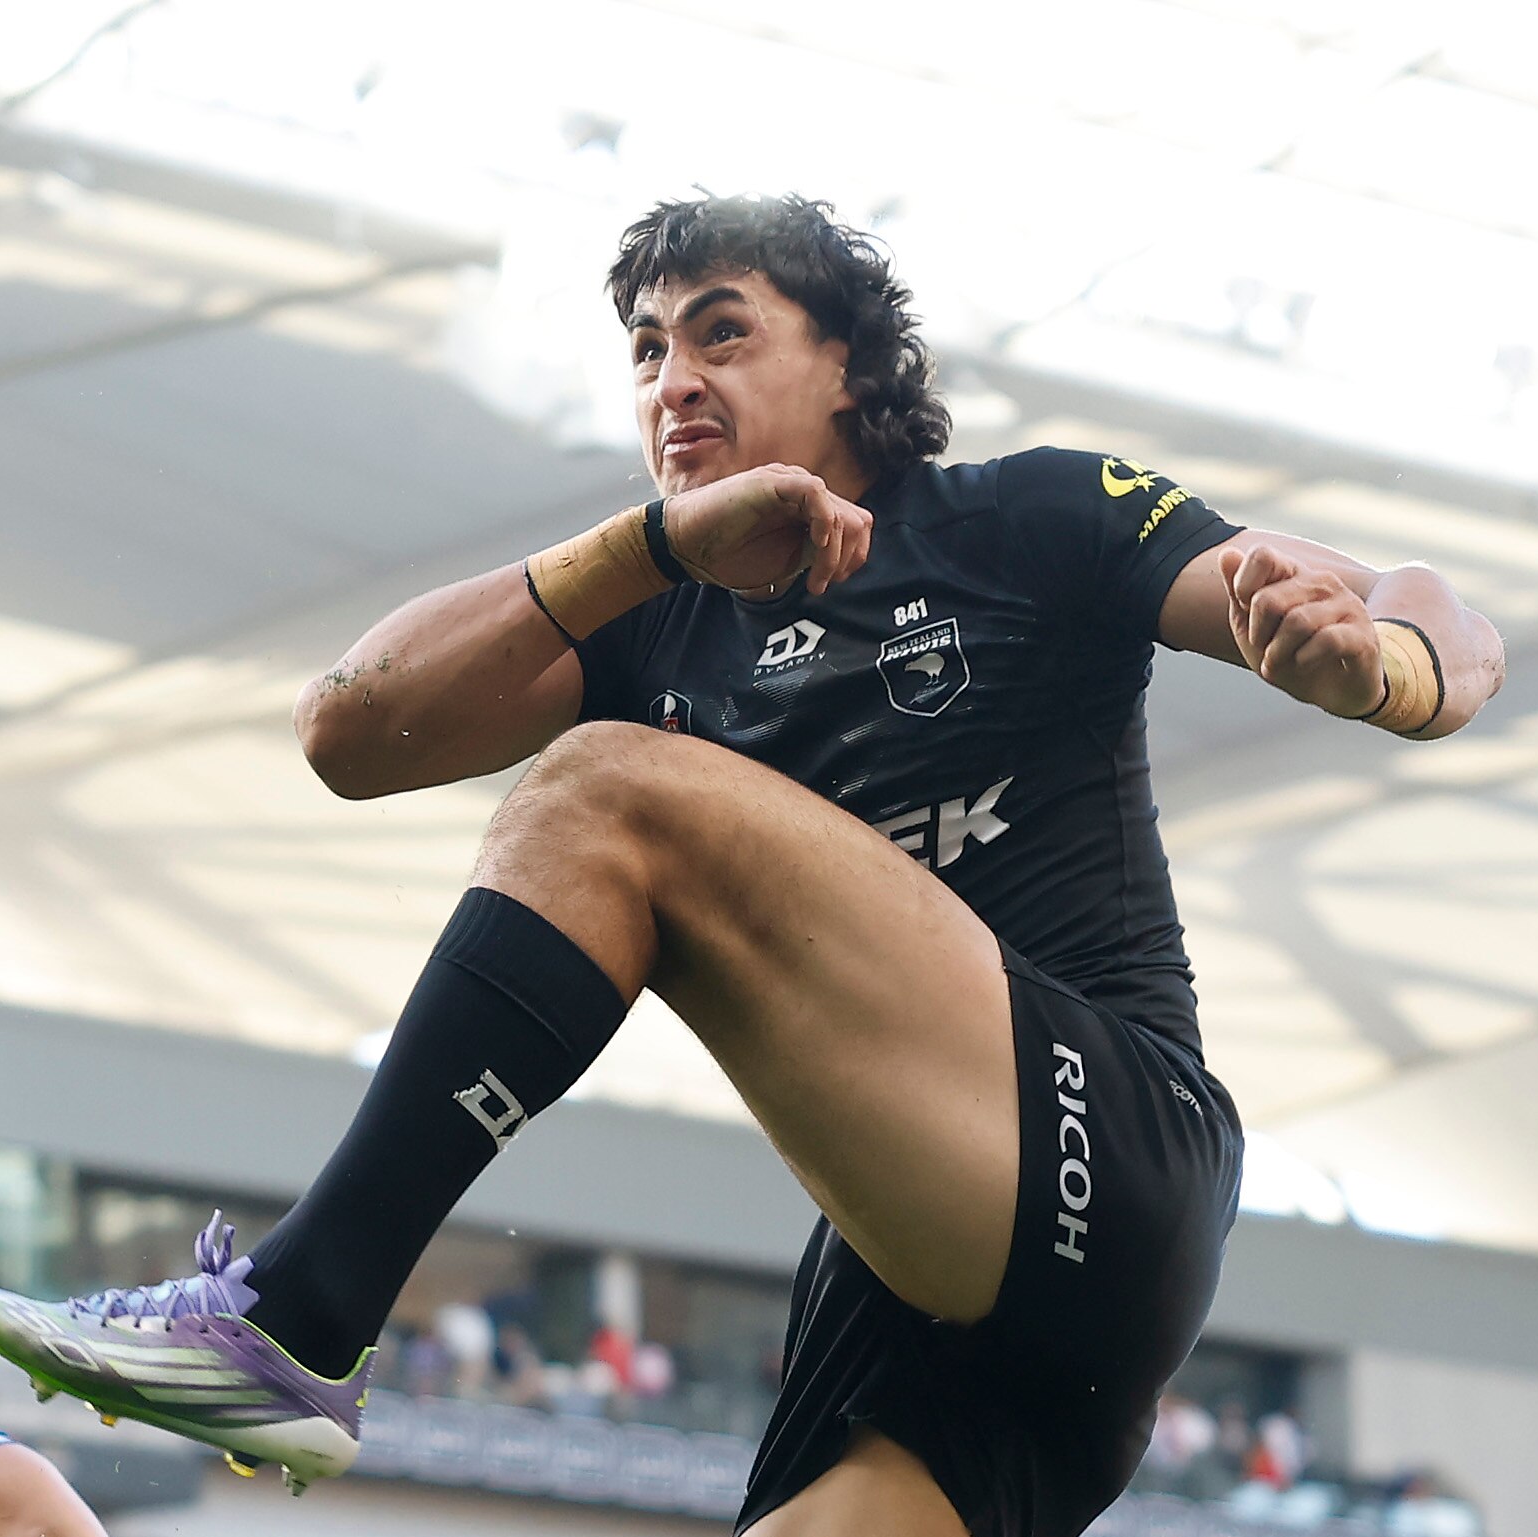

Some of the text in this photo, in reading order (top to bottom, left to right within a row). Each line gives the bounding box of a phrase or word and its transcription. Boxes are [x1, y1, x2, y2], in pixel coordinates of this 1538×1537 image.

[894, 597, 929, 627] 841
[910, 627, 951, 648] ZEALAND
[753, 651, 826, 677] DYNASTY
[1052, 1042, 1093, 1264] RICOH
